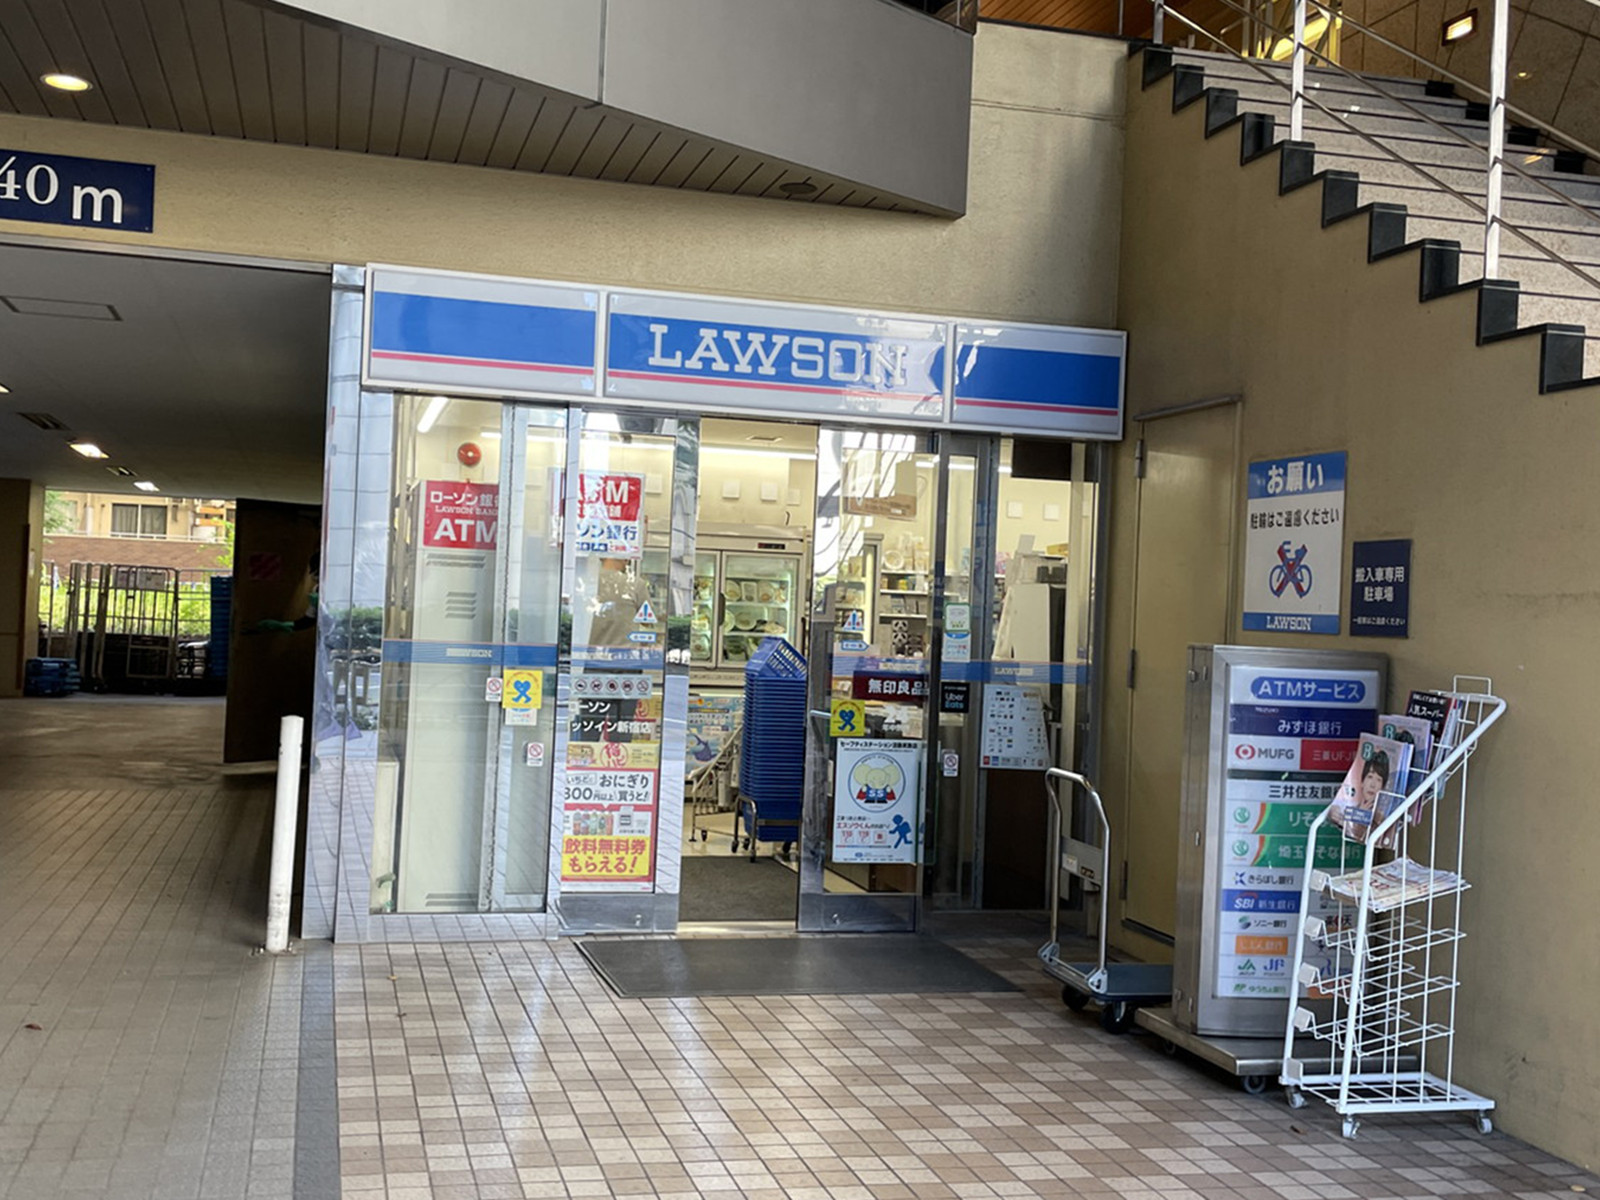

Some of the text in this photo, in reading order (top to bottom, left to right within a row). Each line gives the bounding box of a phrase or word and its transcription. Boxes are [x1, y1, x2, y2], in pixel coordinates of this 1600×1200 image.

[72, 185, 123, 224] m
[648, 323, 908, 387] LAWSON
[1267, 461, 1324, 494] お願い
[1251, 508, 1339, 529] 駐輪はご遠慮ください
[433, 518, 497, 543] ATM
[1355, 567, 1405, 583] 搬入車専用
[1364, 586, 1394, 602] 駐車場
[1266, 616, 1312, 631] LAWSON
[945, 692, 964, 701] Uber
[1258, 681, 1360, 699] ATMサービス
[1278, 720, 1342, 735] みずほ銀行
[1258, 748, 1295, 760] MUFG
[599, 773, 649, 789] おにぎり
[565, 838, 646, 855] 飲料無料券
[569, 855, 638, 874] もらえる!
[1248, 874, 1294, 885] きらぼし銀行
[1234, 897, 1256, 910] SBI
[1254, 919, 1288, 929] ソニー銀行
